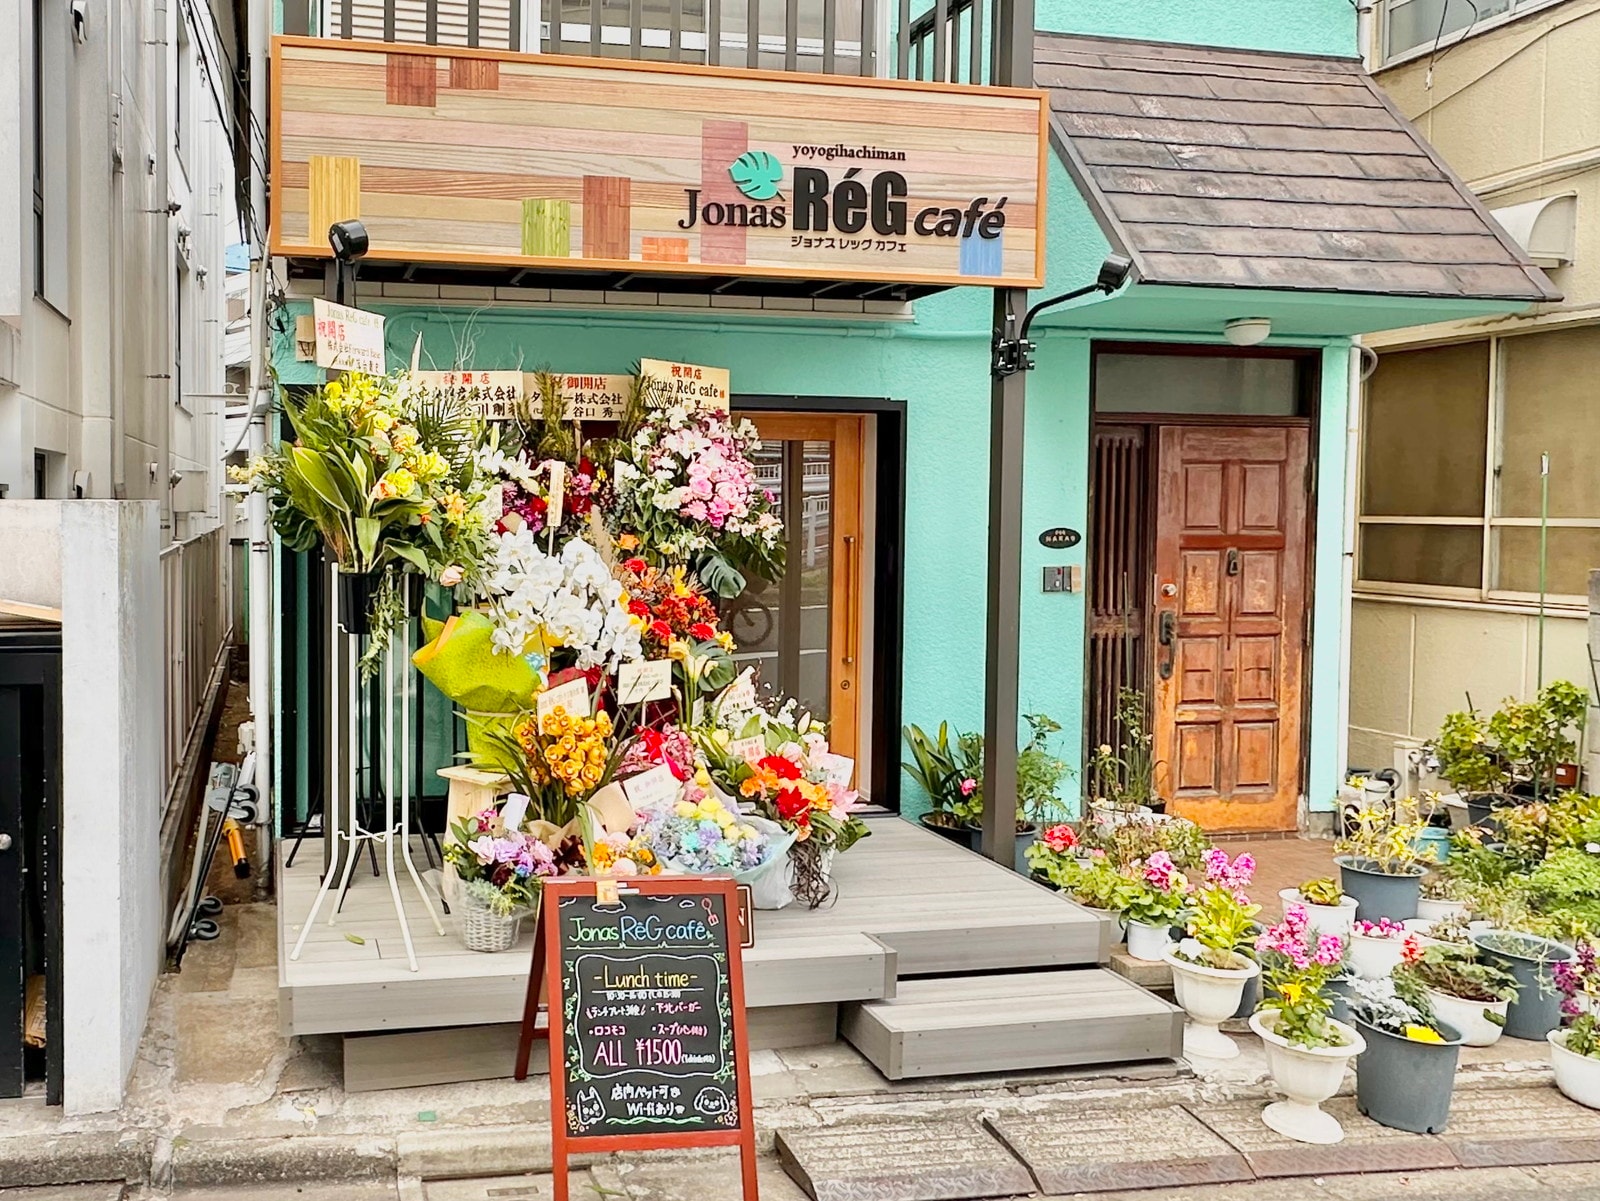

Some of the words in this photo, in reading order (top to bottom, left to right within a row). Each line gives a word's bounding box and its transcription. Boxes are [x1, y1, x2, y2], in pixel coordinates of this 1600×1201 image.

[793, 144, 906, 161] yoyogihachiman
[678, 188, 787, 229] Jonas
[792, 166, 908, 236] RéG
[912, 196, 1009, 240] café
[791, 235, 836, 249] ジョナス
[839, 238, 872, 251] レッグ
[875, 241, 907, 252] カフェ
[671, 364, 702, 380] 祝開店
[676, 379, 696, 395] ReG
[700, 384, 718, 398] cafe
[569, 917, 619, 942] Jonas
[593, 1039, 628, 1066] ALL
